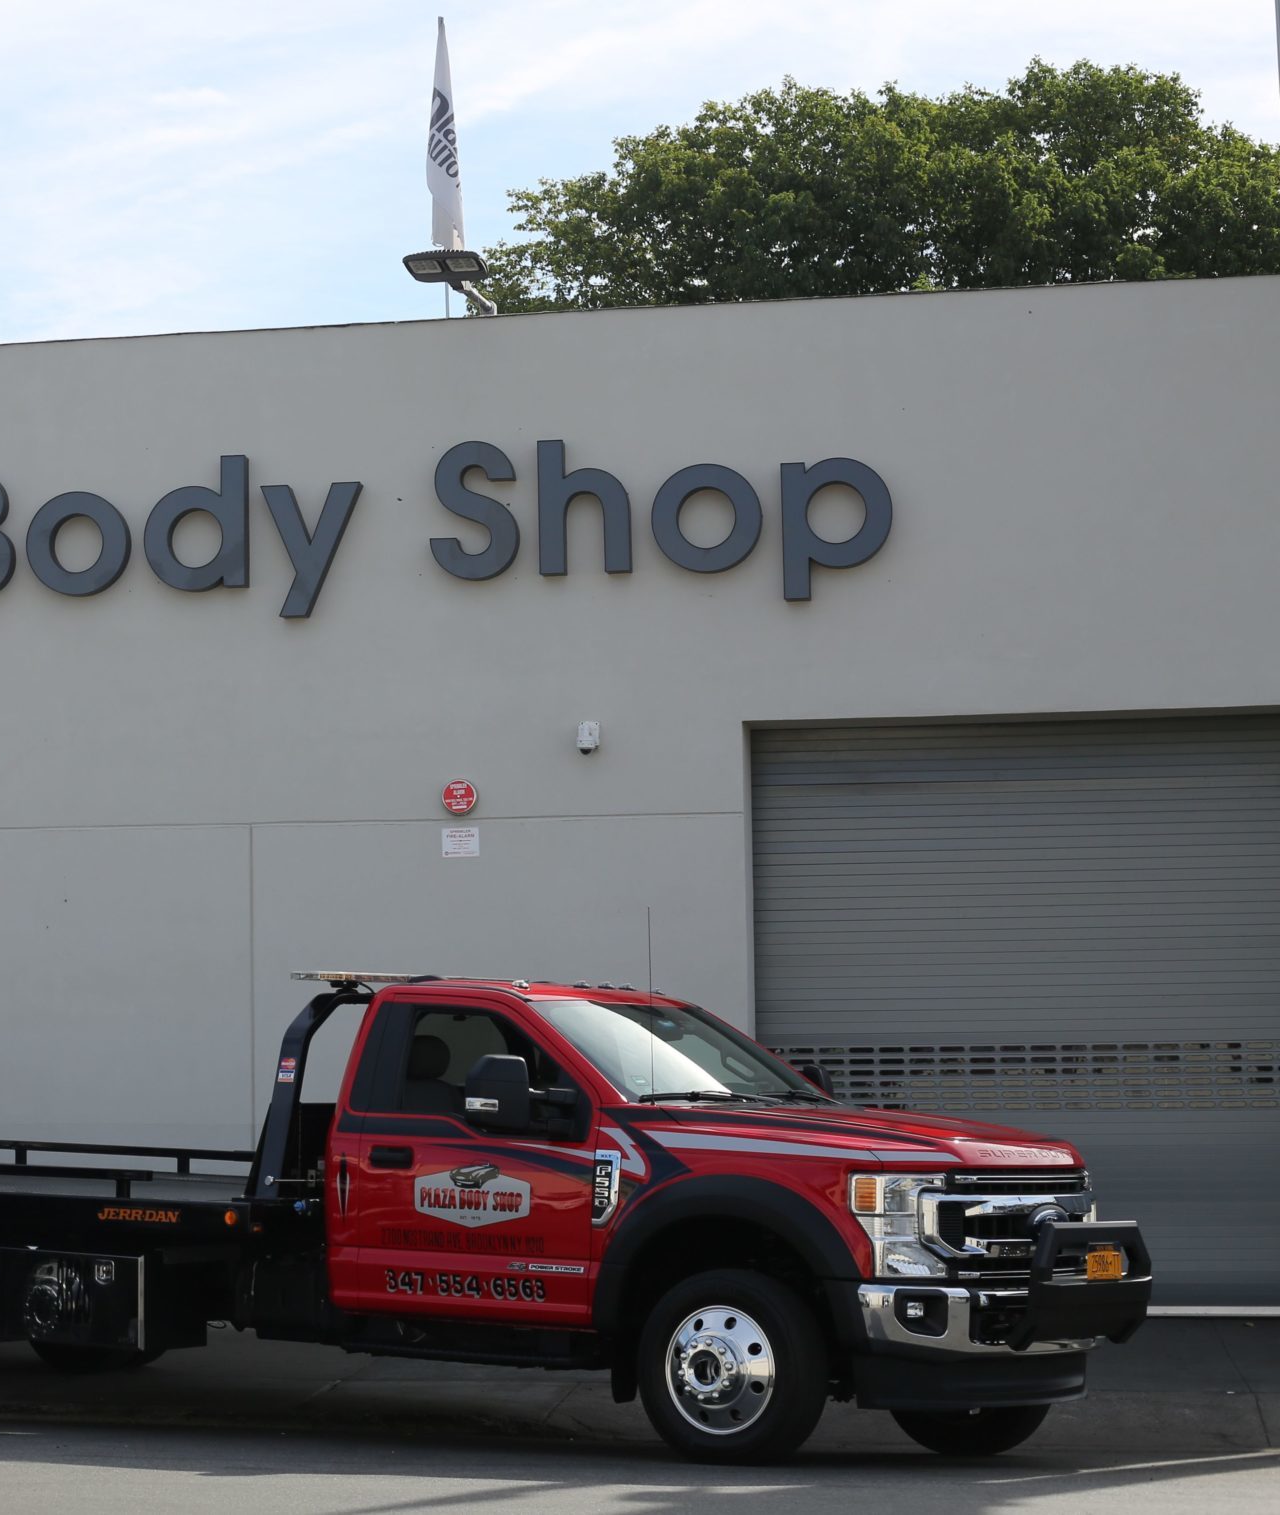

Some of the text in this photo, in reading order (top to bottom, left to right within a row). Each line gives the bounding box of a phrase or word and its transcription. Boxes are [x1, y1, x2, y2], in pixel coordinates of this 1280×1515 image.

[429, 438, 894, 602] Shop
[977, 1149, 1039, 1159] SUPER
[420, 1186, 523, 1213] PLAZA BODY SHOP
